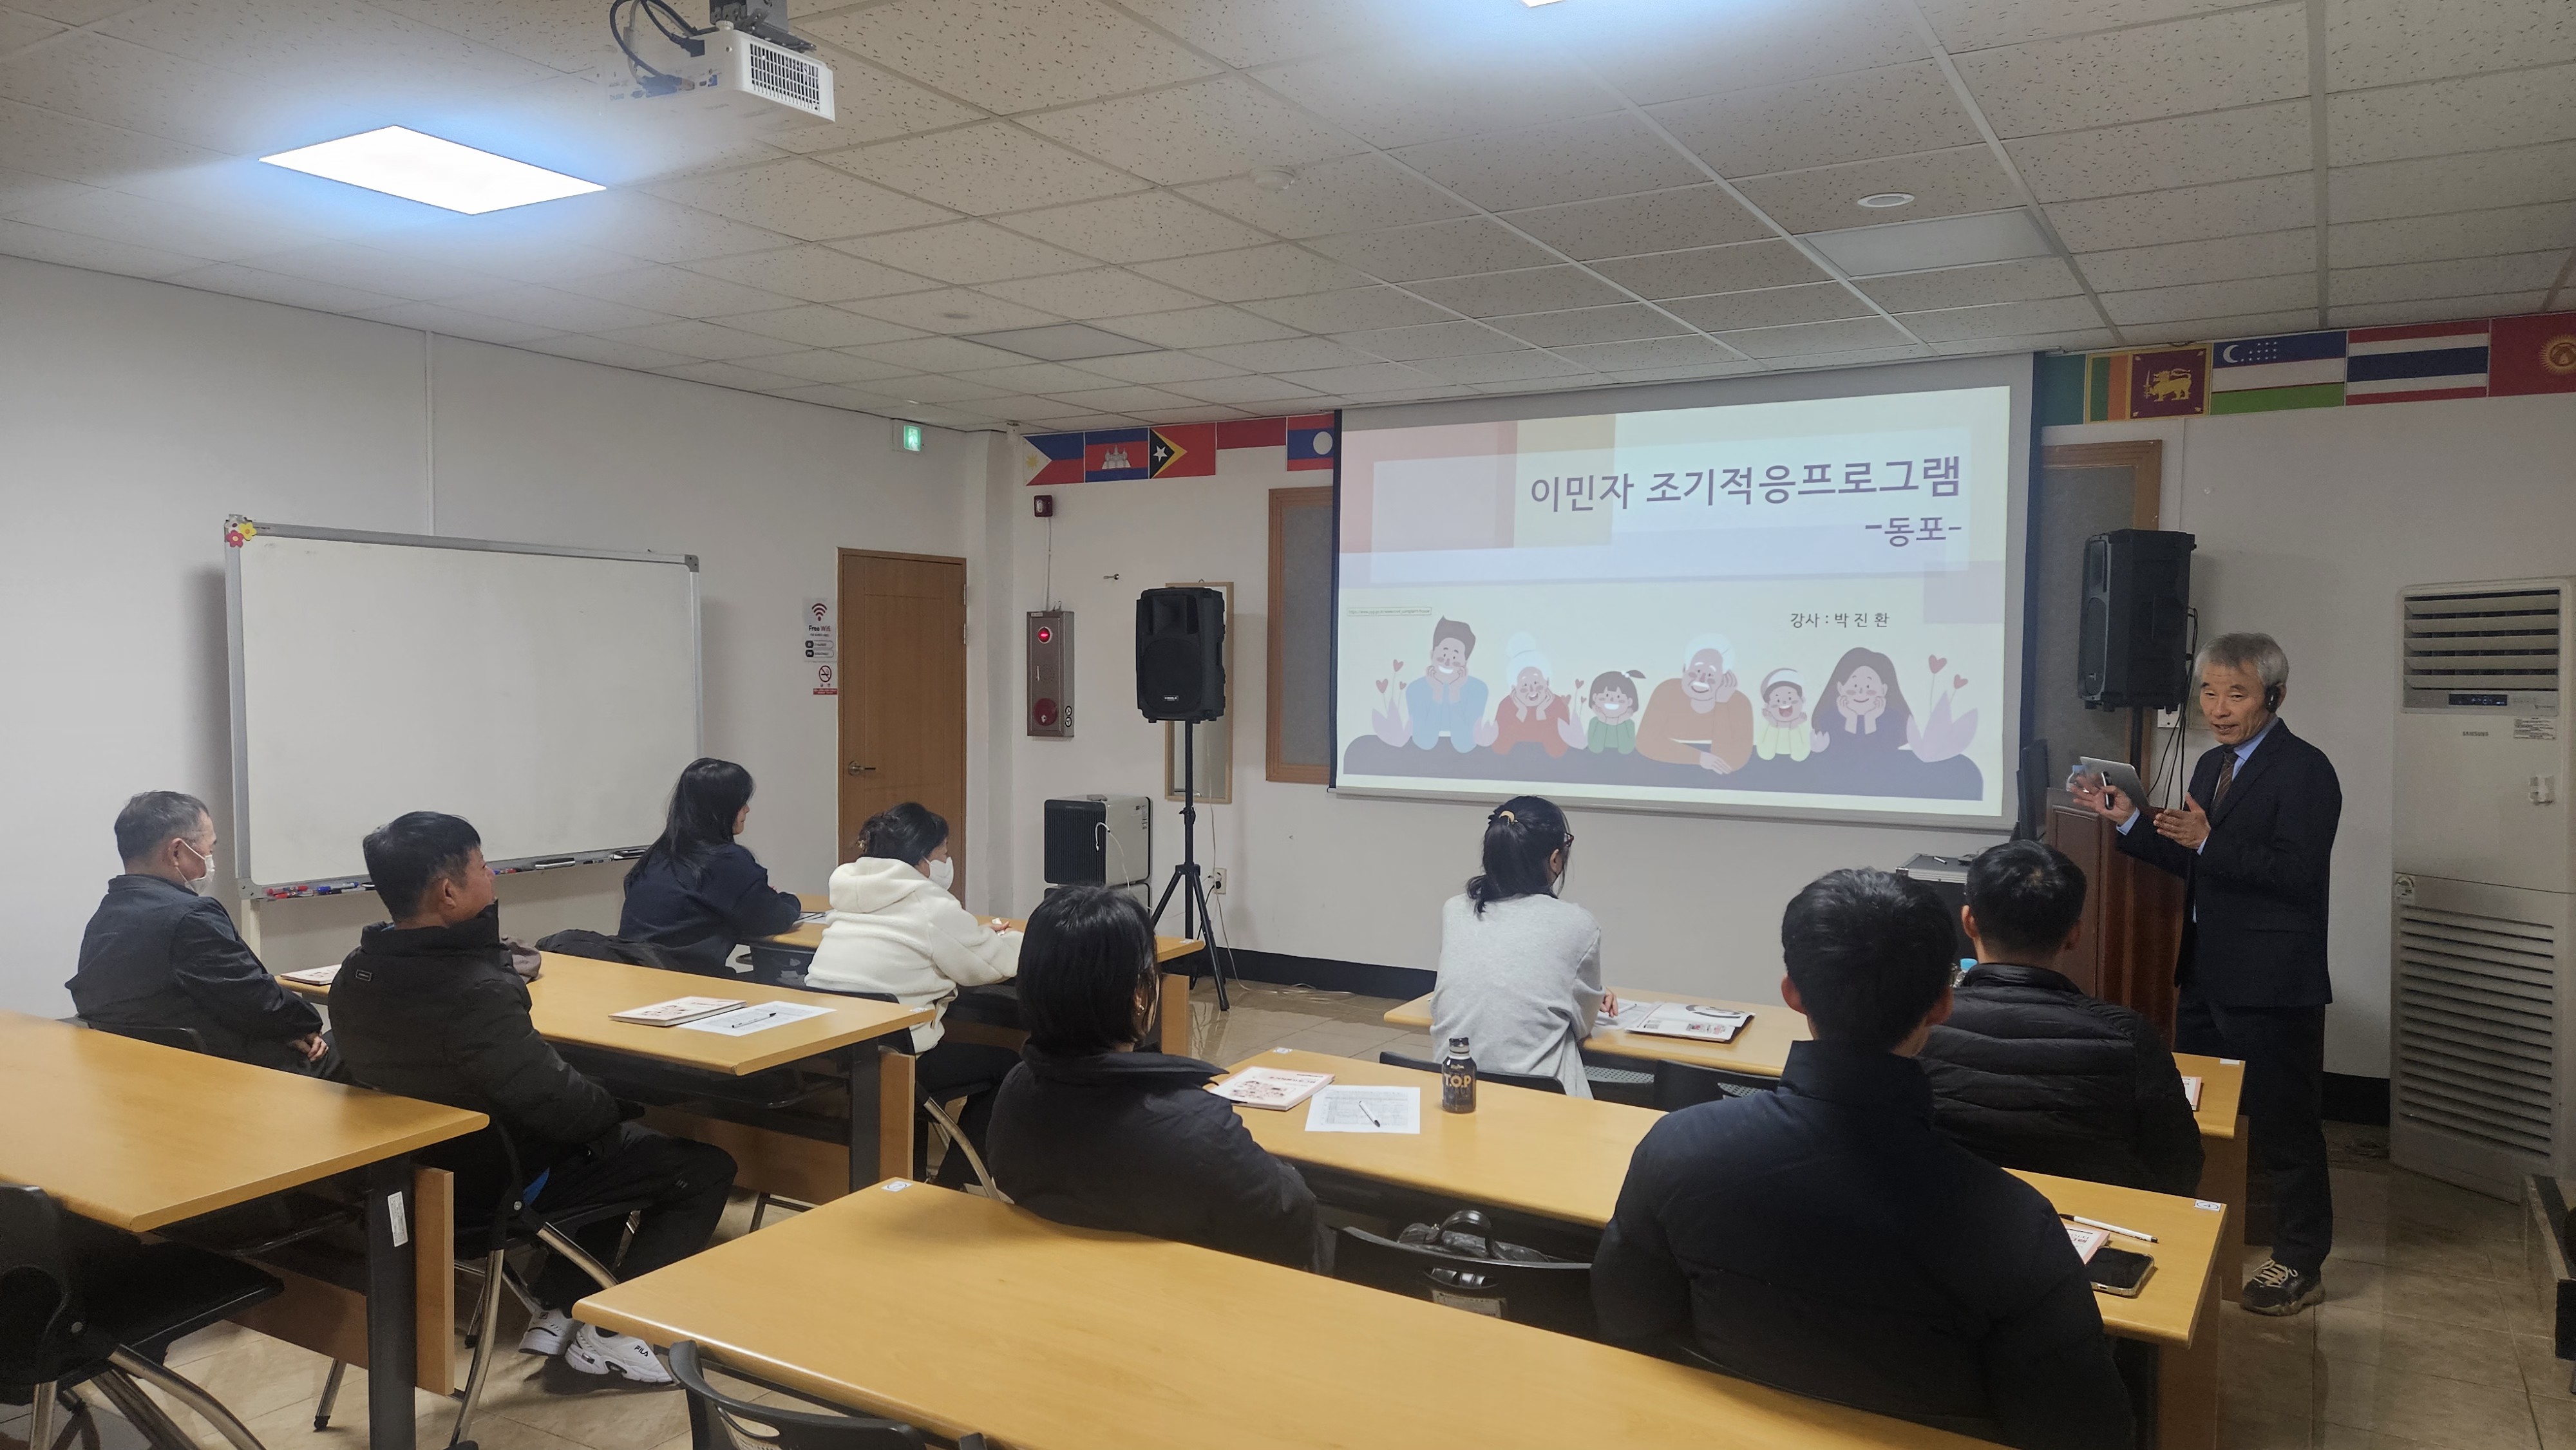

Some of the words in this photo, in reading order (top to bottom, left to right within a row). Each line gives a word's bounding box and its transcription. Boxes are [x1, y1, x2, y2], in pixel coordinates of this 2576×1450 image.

[1530, 473, 1634, 513] 이민자
[1646, 456, 1960, 506] 조기적응프로그램
[1865, 516, 1963, 547] -동포-
[1790, 612, 1820, 628] 강사
[634, 1344, 649, 1357] FILA
